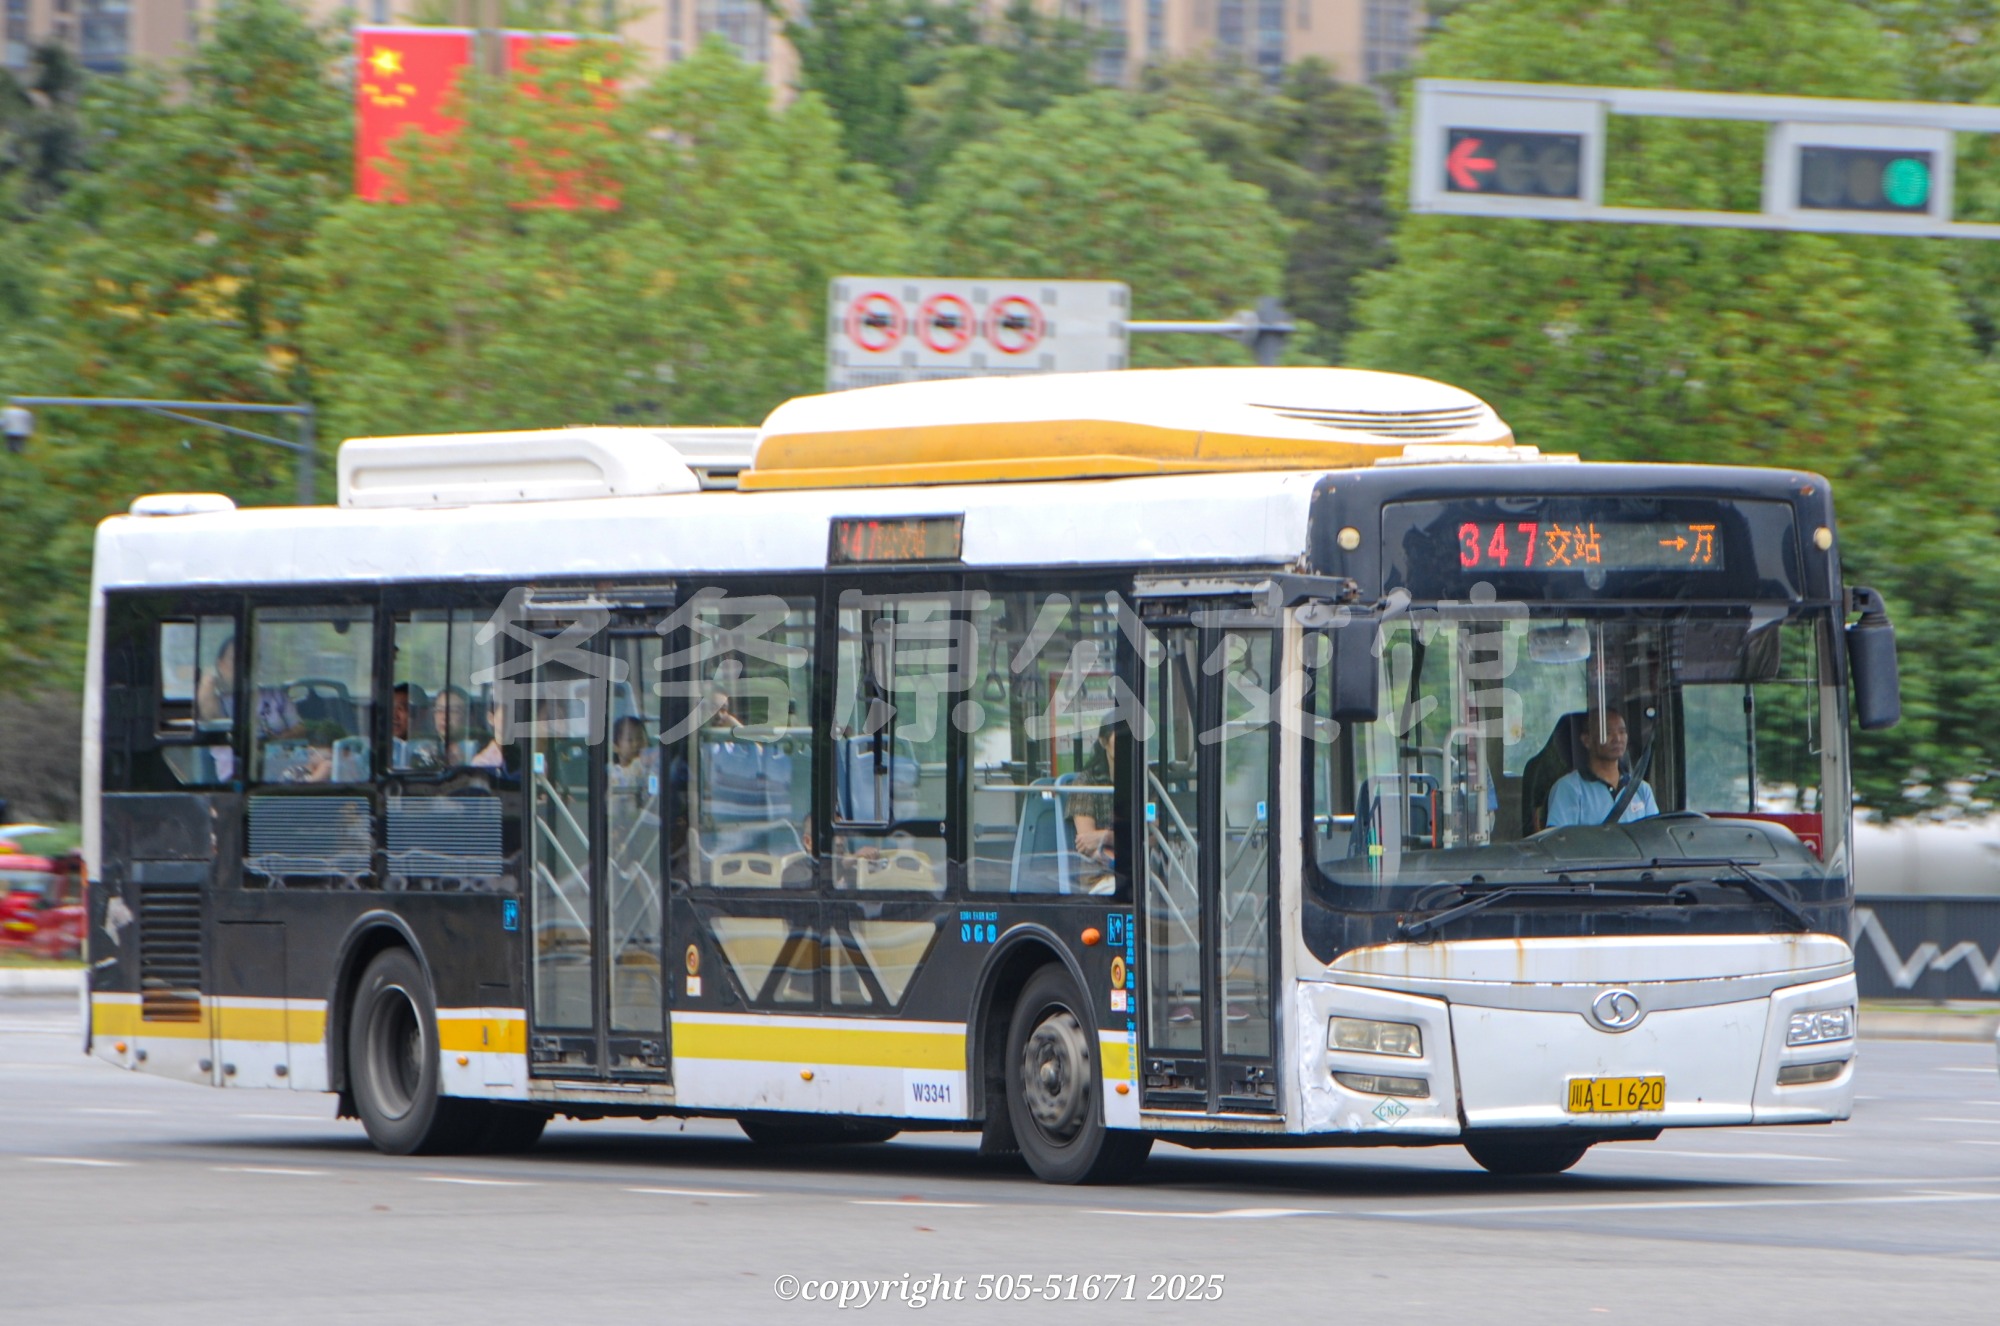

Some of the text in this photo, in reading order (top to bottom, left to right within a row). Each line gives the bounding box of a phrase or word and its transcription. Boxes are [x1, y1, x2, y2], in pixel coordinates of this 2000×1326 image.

[1458, 522, 1716, 567] 347 交站 万
[912, 1083, 951, 1103] W3341
[1379, 1105, 1403, 1118] CNG
